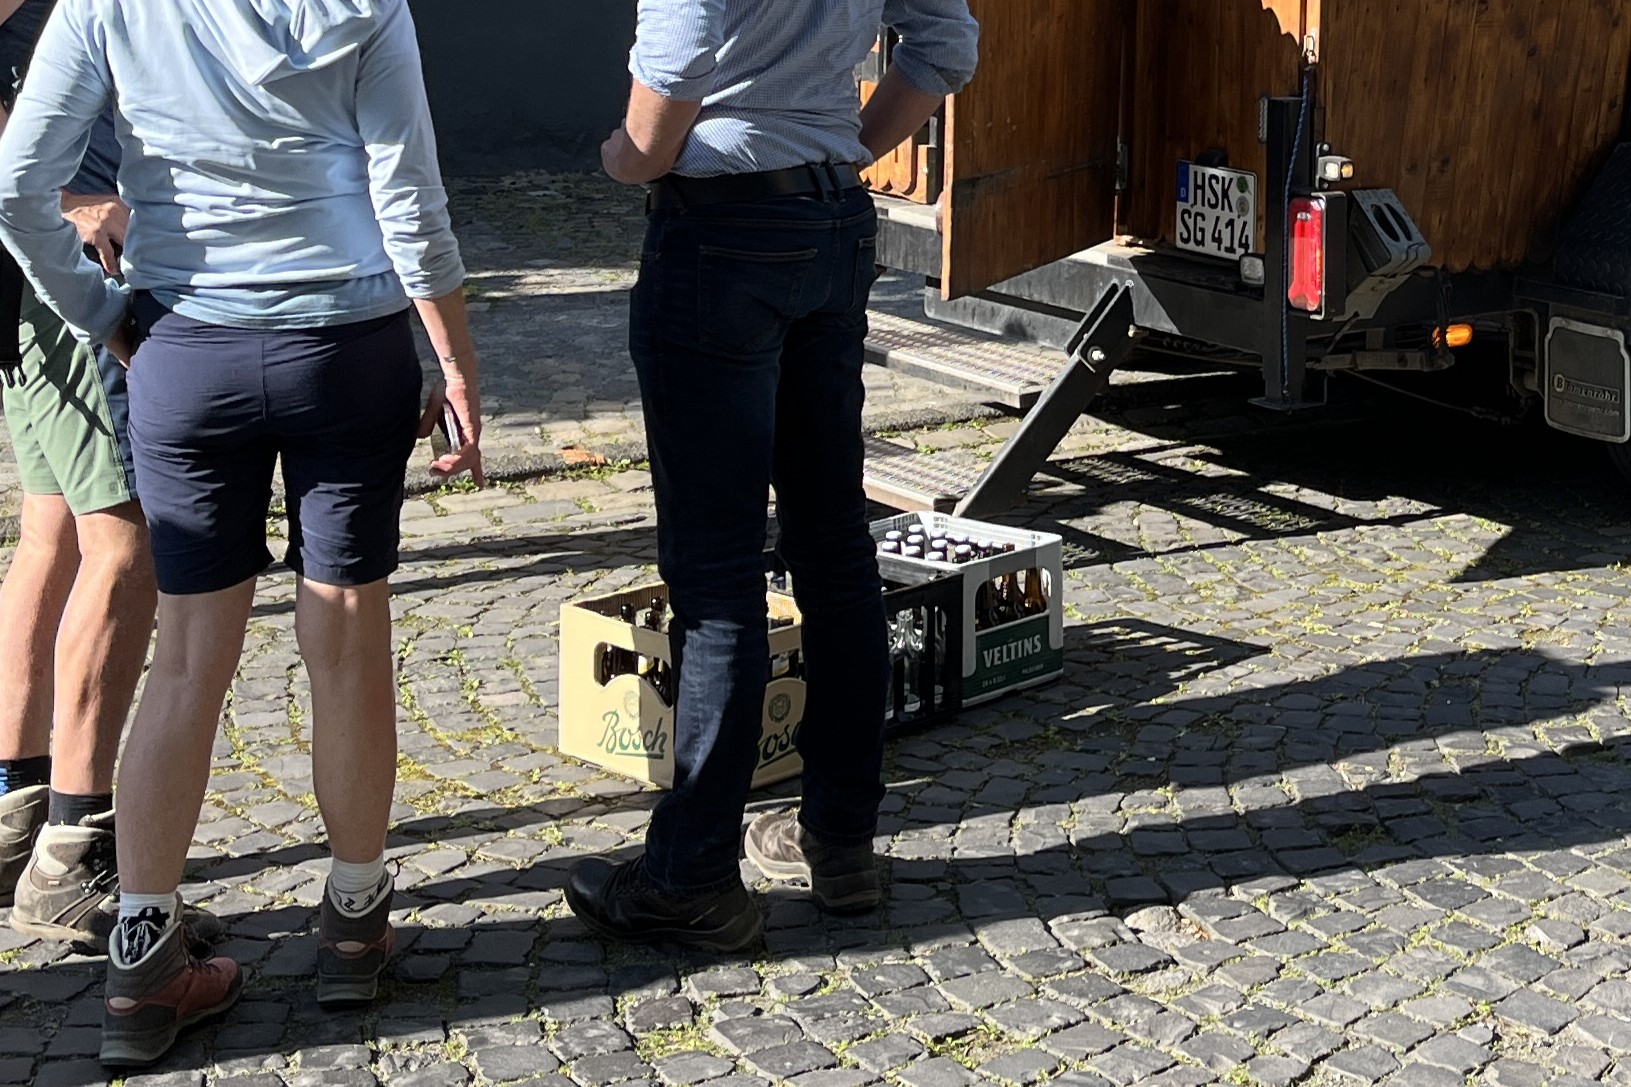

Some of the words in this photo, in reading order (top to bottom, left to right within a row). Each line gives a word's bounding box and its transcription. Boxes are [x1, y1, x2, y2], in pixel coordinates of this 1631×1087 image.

[1180, 187, 1187, 198] D
[1193, 170, 1234, 213] HSK
[1179, 208, 1206, 248] SG
[1211, 215, 1250, 255] 414
[982, 634, 1042, 669] VELTINS
[597, 708, 668, 755] Bosch
